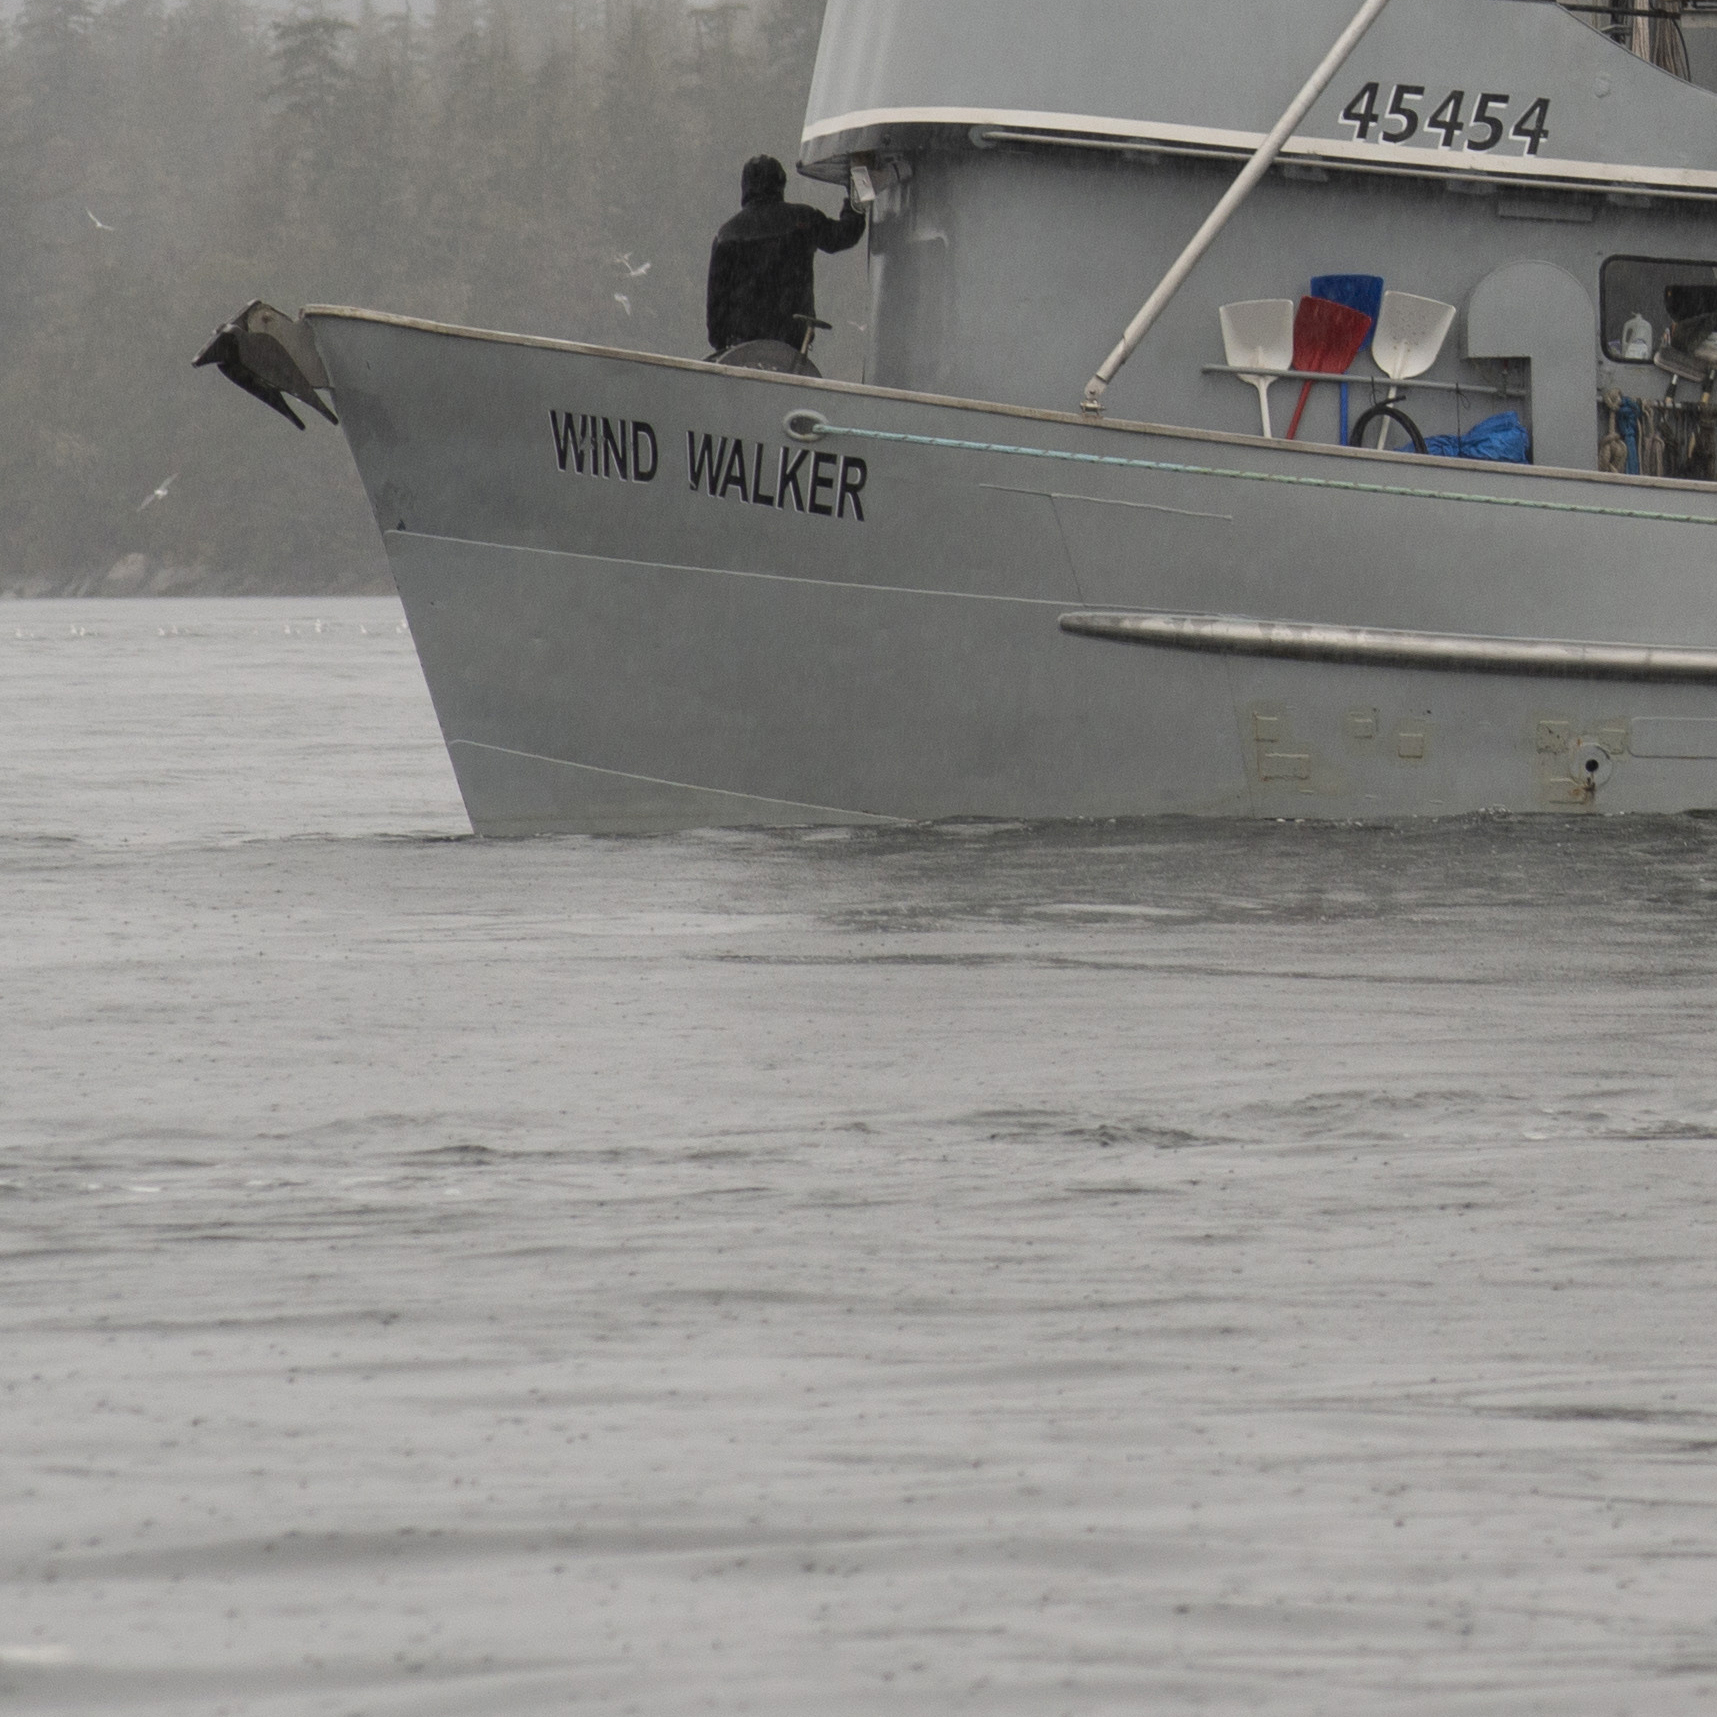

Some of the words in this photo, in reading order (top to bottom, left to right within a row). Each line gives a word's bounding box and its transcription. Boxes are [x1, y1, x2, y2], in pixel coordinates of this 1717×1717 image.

[1339, 82, 1550, 157] 45454
[550, 409, 658, 483] WIND
[686, 430, 867, 522] WALKER
